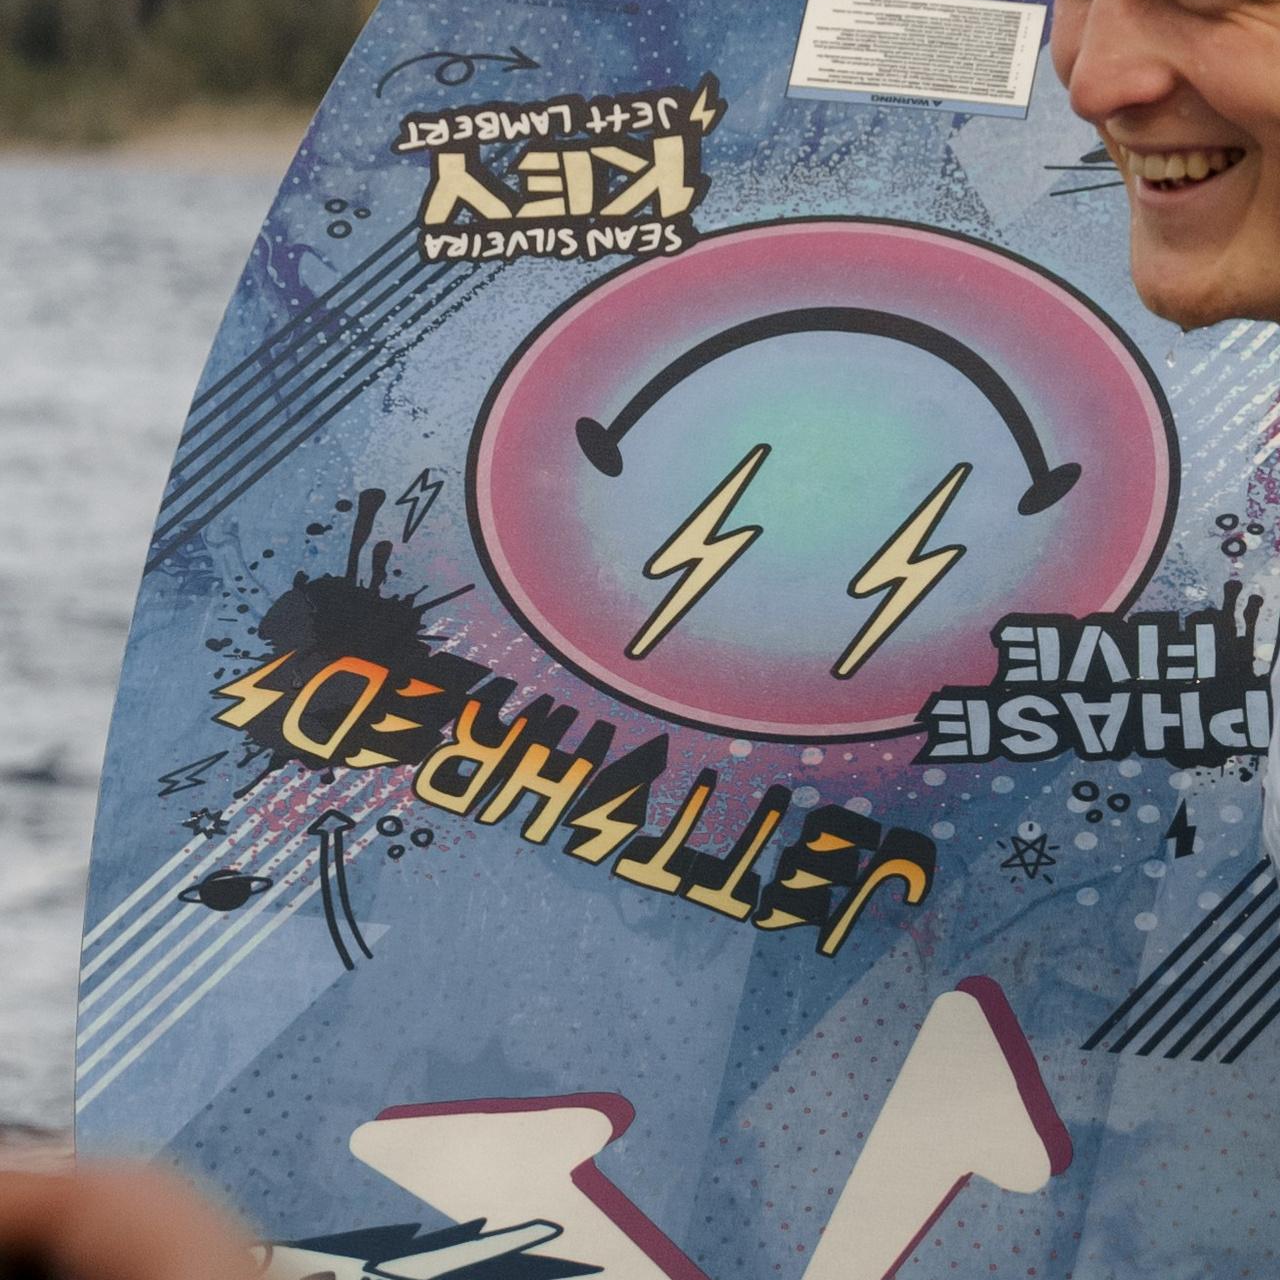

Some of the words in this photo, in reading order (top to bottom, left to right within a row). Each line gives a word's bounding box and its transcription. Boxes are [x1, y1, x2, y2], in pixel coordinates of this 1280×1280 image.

[870, 94, 930, 106] WARNING
[397, 103, 572, 151] LAMBERT
[424, 134, 695, 225] KEY
[424, 227, 579, 260] SILVEIRA
[586, 223, 682, 258] SEAN
[1000, 622, 1217, 682] FIVE
[929, 688, 1270, 757] PHASE
